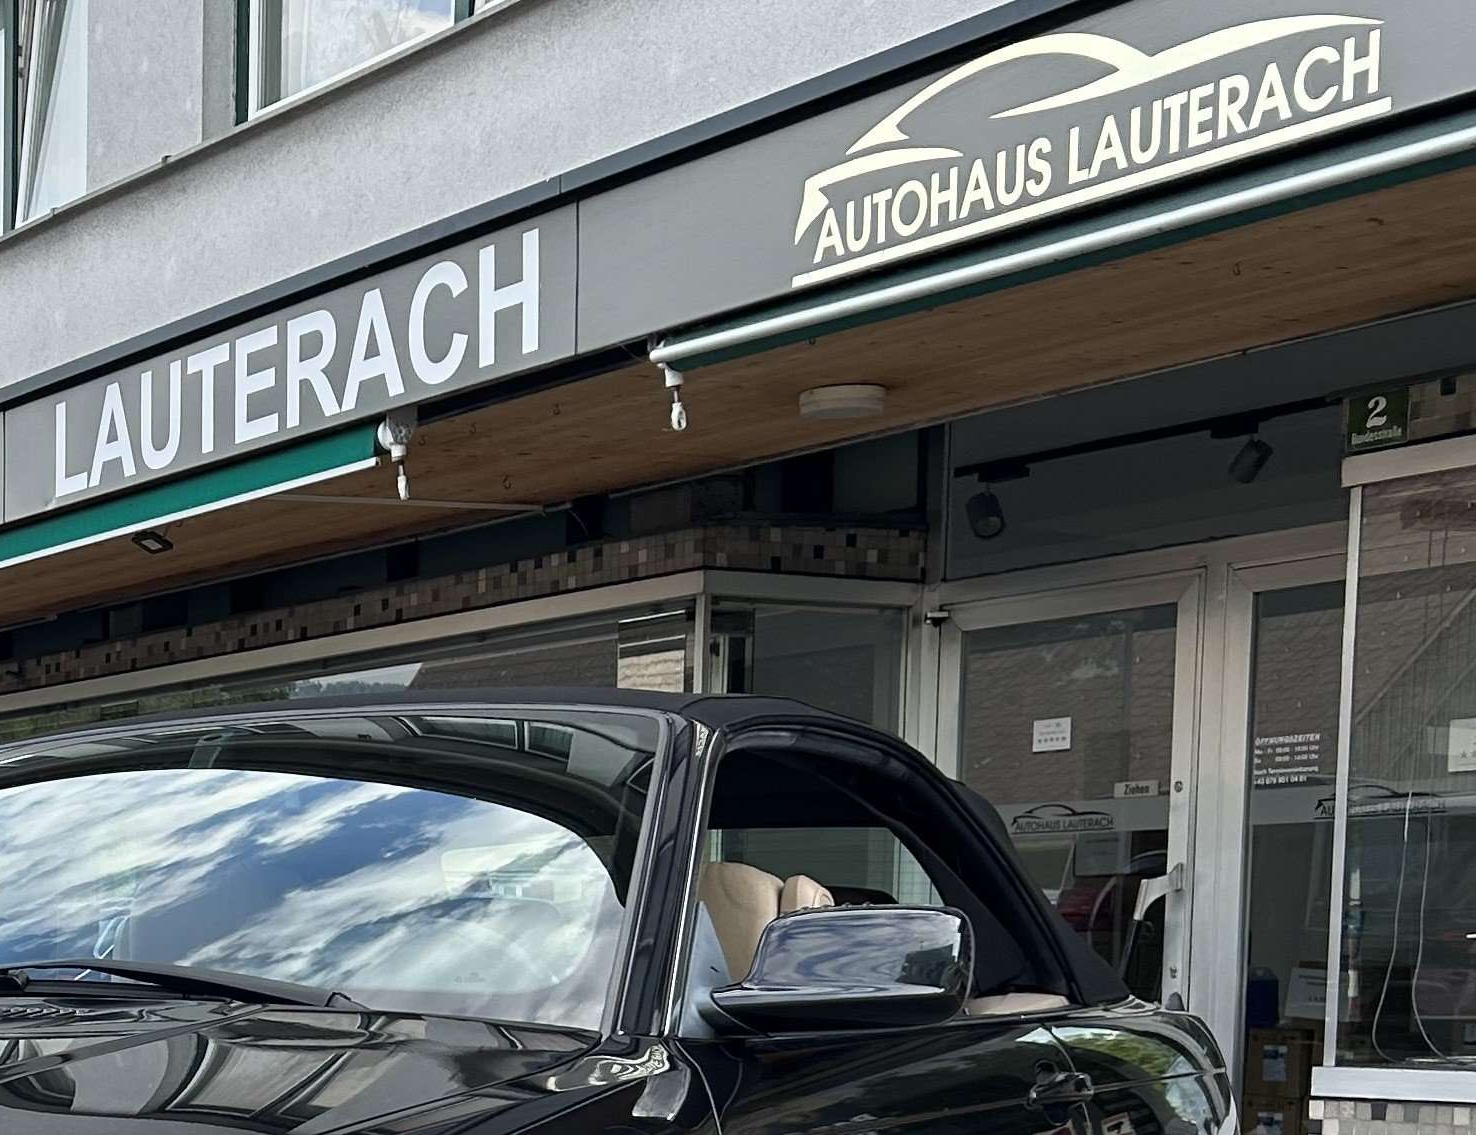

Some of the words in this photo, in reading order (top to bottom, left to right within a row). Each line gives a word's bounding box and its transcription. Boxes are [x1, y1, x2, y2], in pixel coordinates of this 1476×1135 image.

[812, 144, 1052, 264] AUTOHAUS
[1067, 28, 1381, 183] LAUTERACH
[54, 227, 540, 499] LAUTERACH
[1365, 395, 1388, 429] 2
[1014, 819, 1062, 832] AUTOHAUS
[1063, 816, 1115, 830] LAUTERACH
